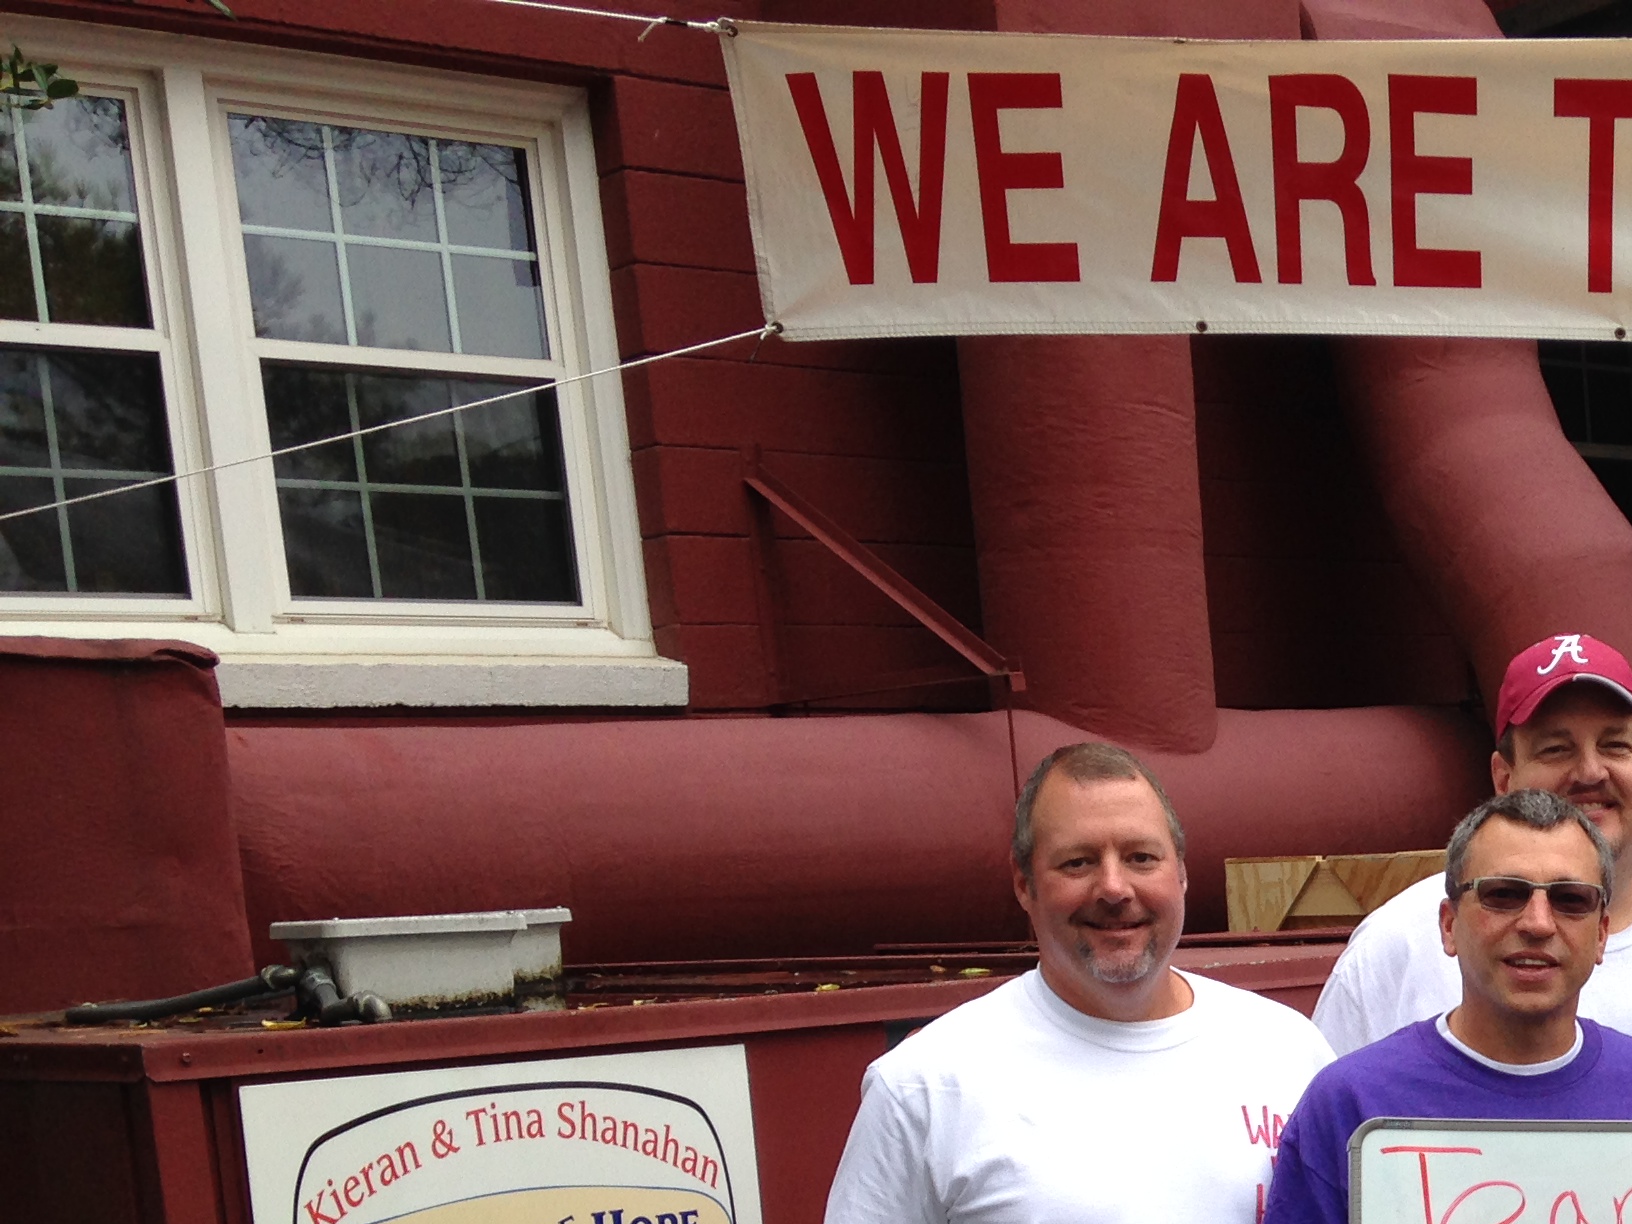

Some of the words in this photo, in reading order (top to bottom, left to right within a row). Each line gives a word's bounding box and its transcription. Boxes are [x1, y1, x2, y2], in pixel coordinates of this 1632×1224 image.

[785, 70, 1081, 286] WE
[1150, 72, 1484, 289] ARE
[1537, 634, 1589, 675] A
[431, 1119, 461, 1160] &
[465, 1102, 546, 1147] Tina
[557, 1101, 720, 1189] Shanahan
